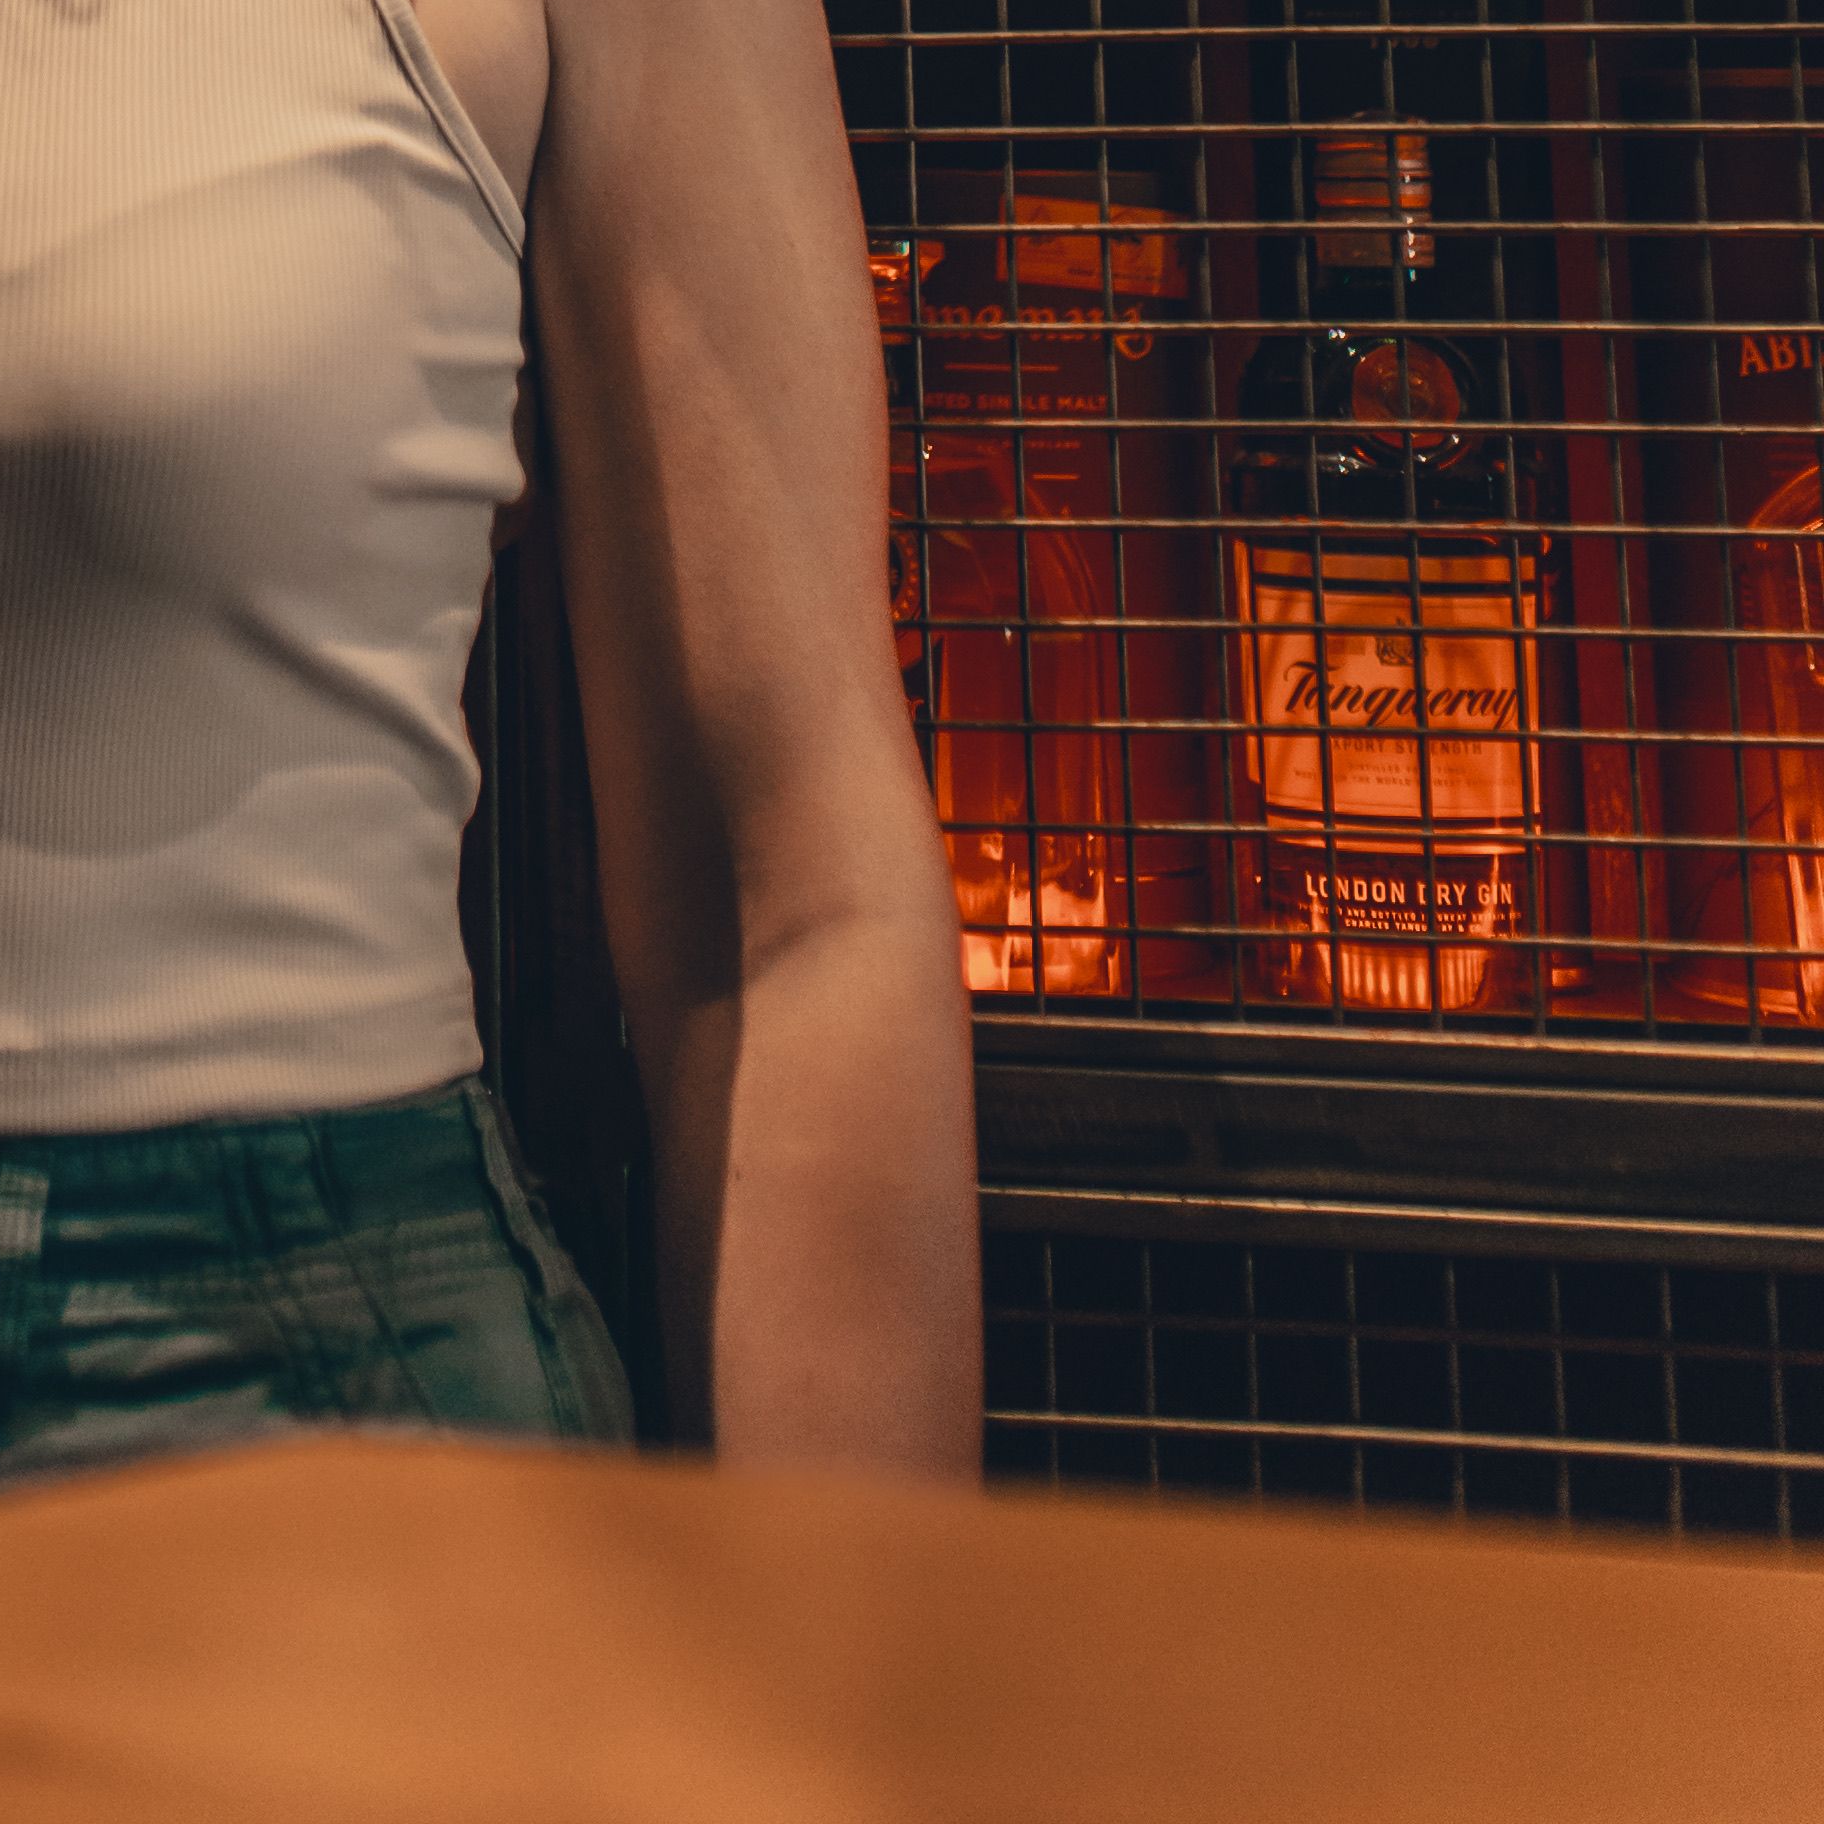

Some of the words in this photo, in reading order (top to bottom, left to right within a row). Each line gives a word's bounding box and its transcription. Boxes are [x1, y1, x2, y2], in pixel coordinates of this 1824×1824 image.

[976, 393, 1050, 411] SINLE
[1332, 738, 1385, 754] XPORT
[1395, 740, 1483, 755] STENGTH
[1305, 872, 1407, 905] LONDON
[1417, 881, 1467, 907] DRY
[1477, 882, 1514, 906] GIN
